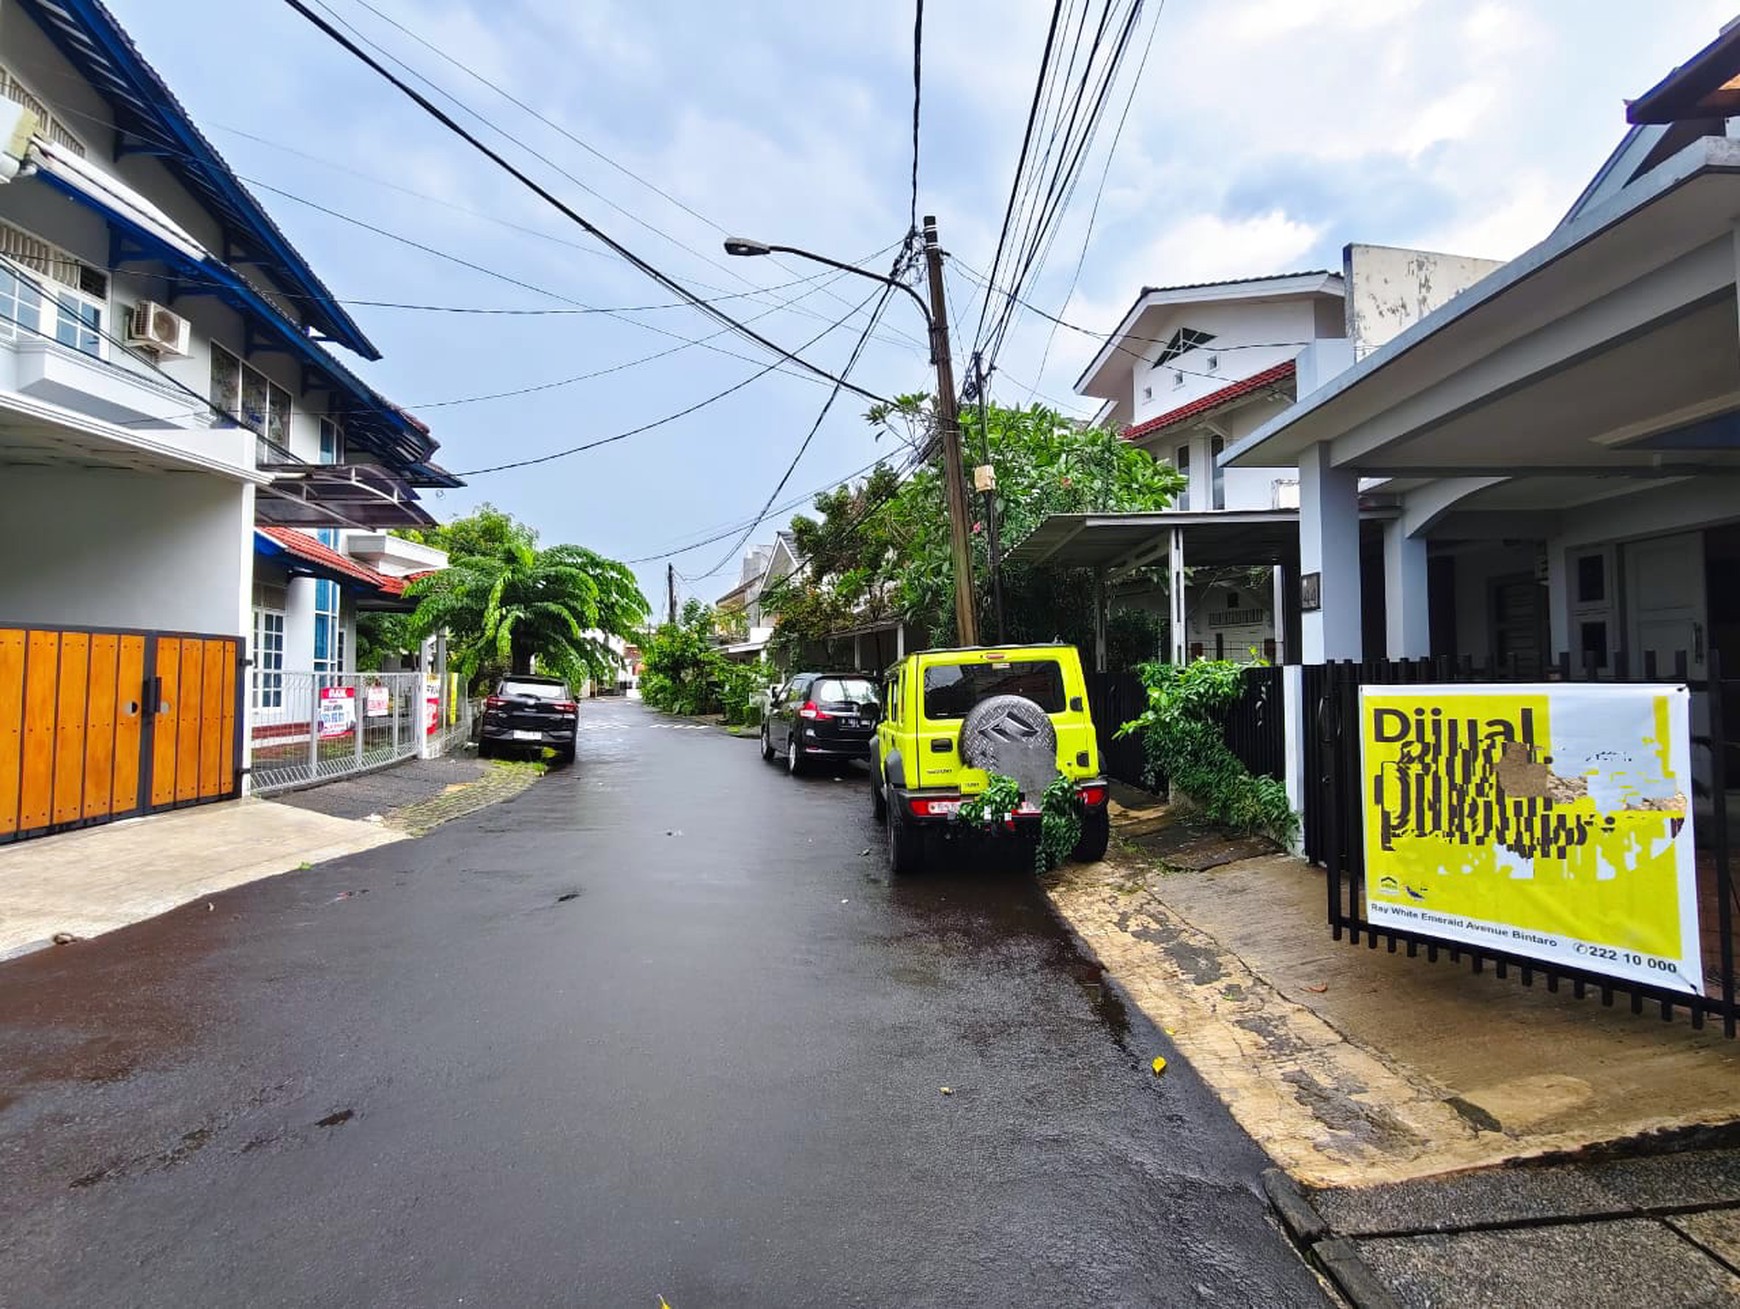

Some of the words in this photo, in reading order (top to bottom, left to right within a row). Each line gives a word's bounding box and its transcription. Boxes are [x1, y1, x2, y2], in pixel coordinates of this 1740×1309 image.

[1371, 903, 1389, 915] Ray
[1392, 906, 1419, 920] White
[1421, 912, 1463, 928] Emerald
[1466, 920, 1508, 937] Avenue
[1512, 929, 1557, 948] Bintaro
[1588, 946, 1618, 961] 222
[1623, 952, 1642, 966] 10
[1648, 958, 1678, 974] 000
